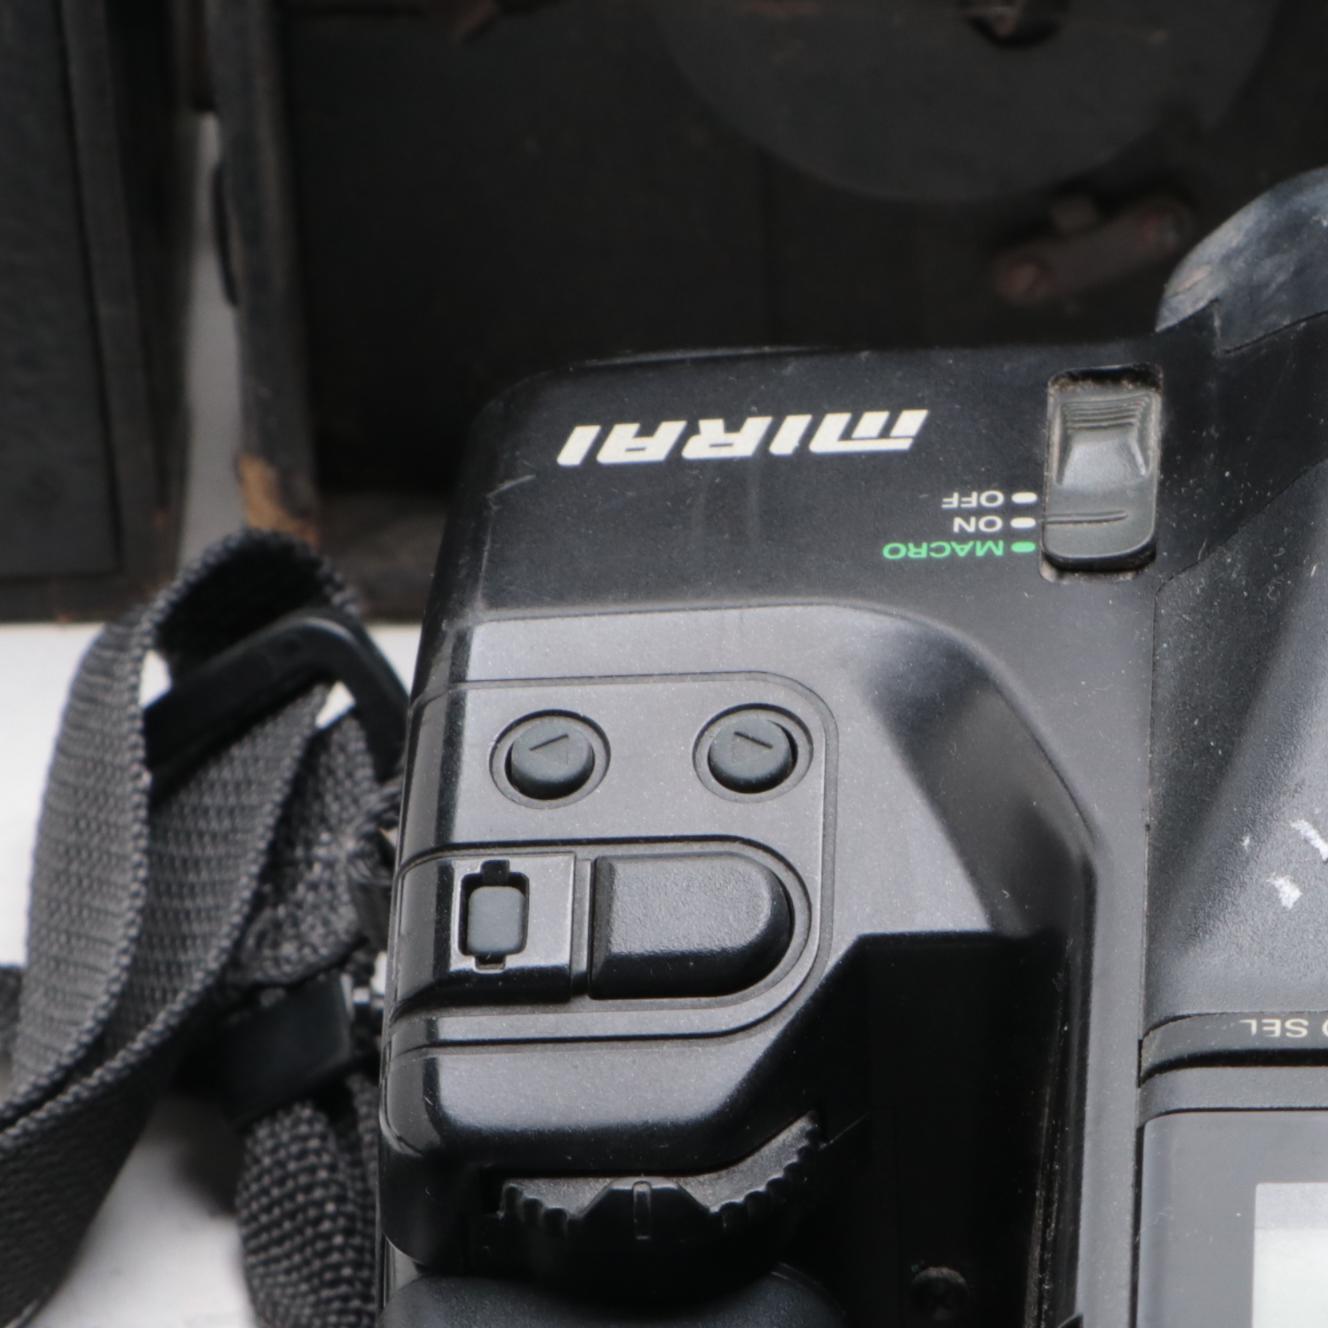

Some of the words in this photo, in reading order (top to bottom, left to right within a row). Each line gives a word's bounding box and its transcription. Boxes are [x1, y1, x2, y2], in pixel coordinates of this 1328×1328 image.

[556, 409, 929, 467] MIRAI
[941, 489, 1005, 509] OFF
[952, 514, 1004, 534] ON
[882, 540, 1005, 560] MACRO
[1239, 1017, 1310, 1039] SEL
